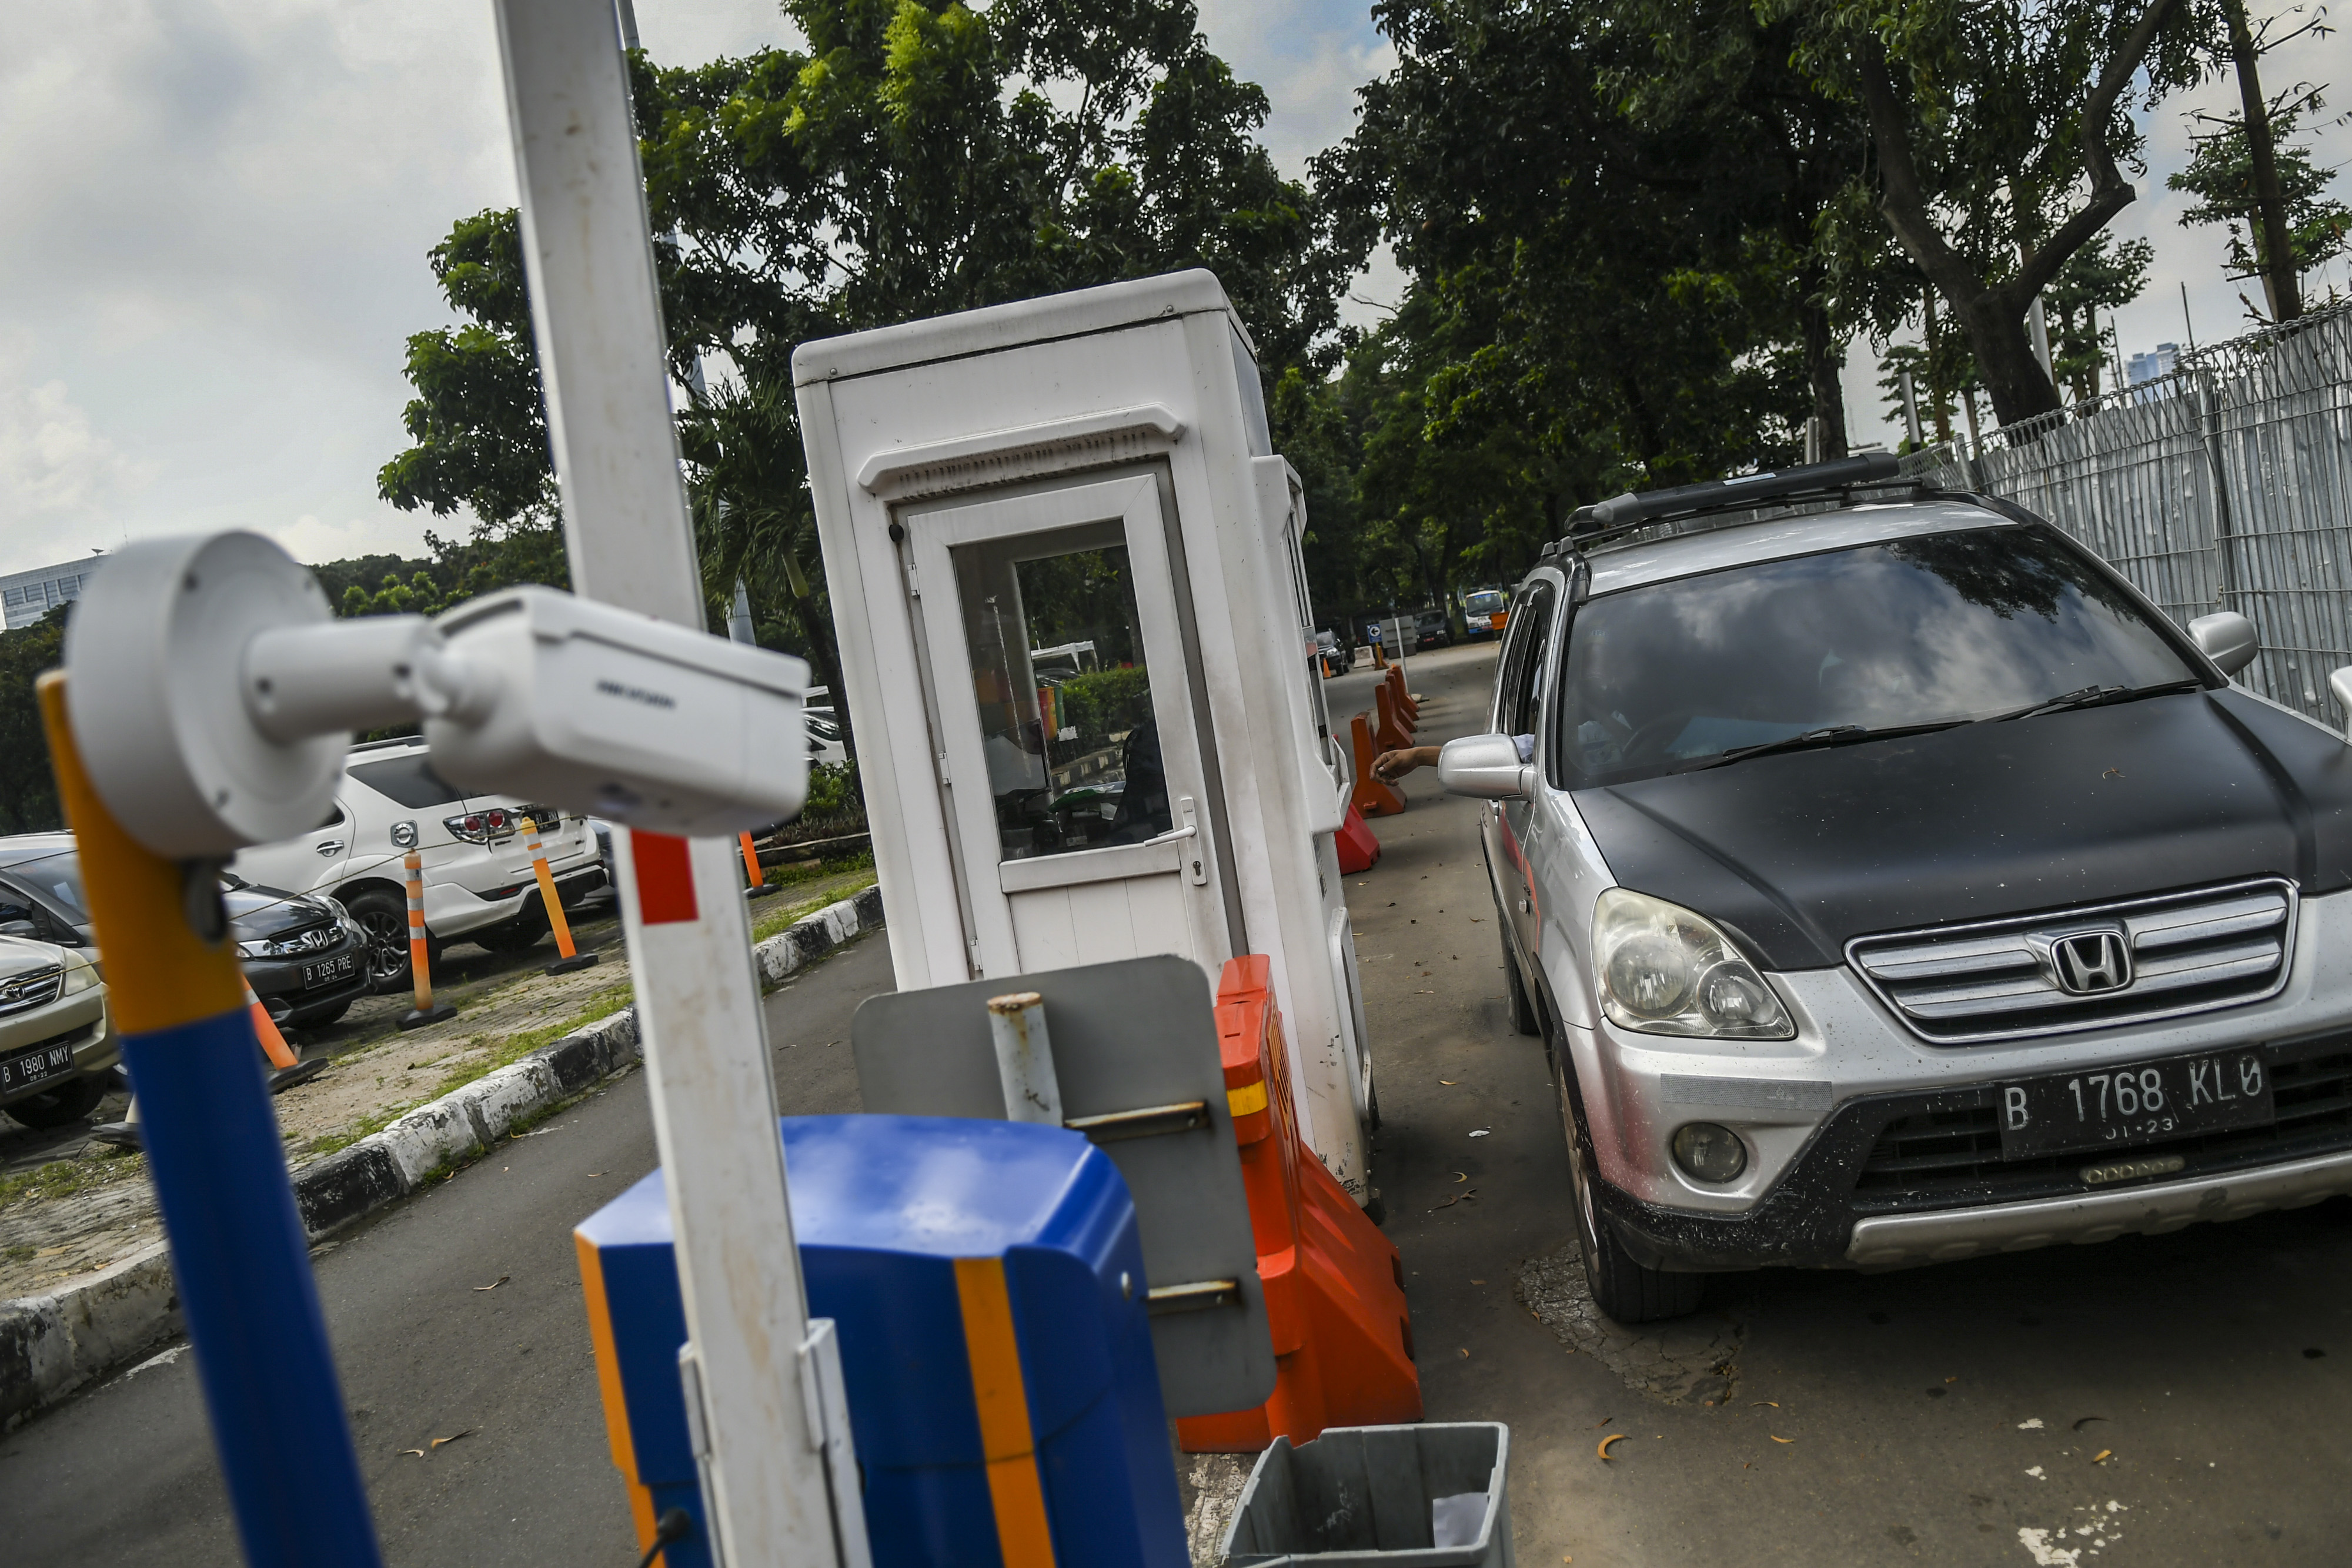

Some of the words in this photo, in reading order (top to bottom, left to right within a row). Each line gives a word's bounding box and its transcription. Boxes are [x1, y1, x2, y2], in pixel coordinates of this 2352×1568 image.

[306, 967, 312, 981] B
[317, 961, 335, 977] 1265
[338, 956, 352, 971] PRE
[3, 1066, 11, 1082] B
[20, 1055, 45, 1076] 1980
[49, 1046, 68, 1066] NMY
[2004, 1087, 2029, 1131] B
[2068, 1068, 2164, 1122] 1768
